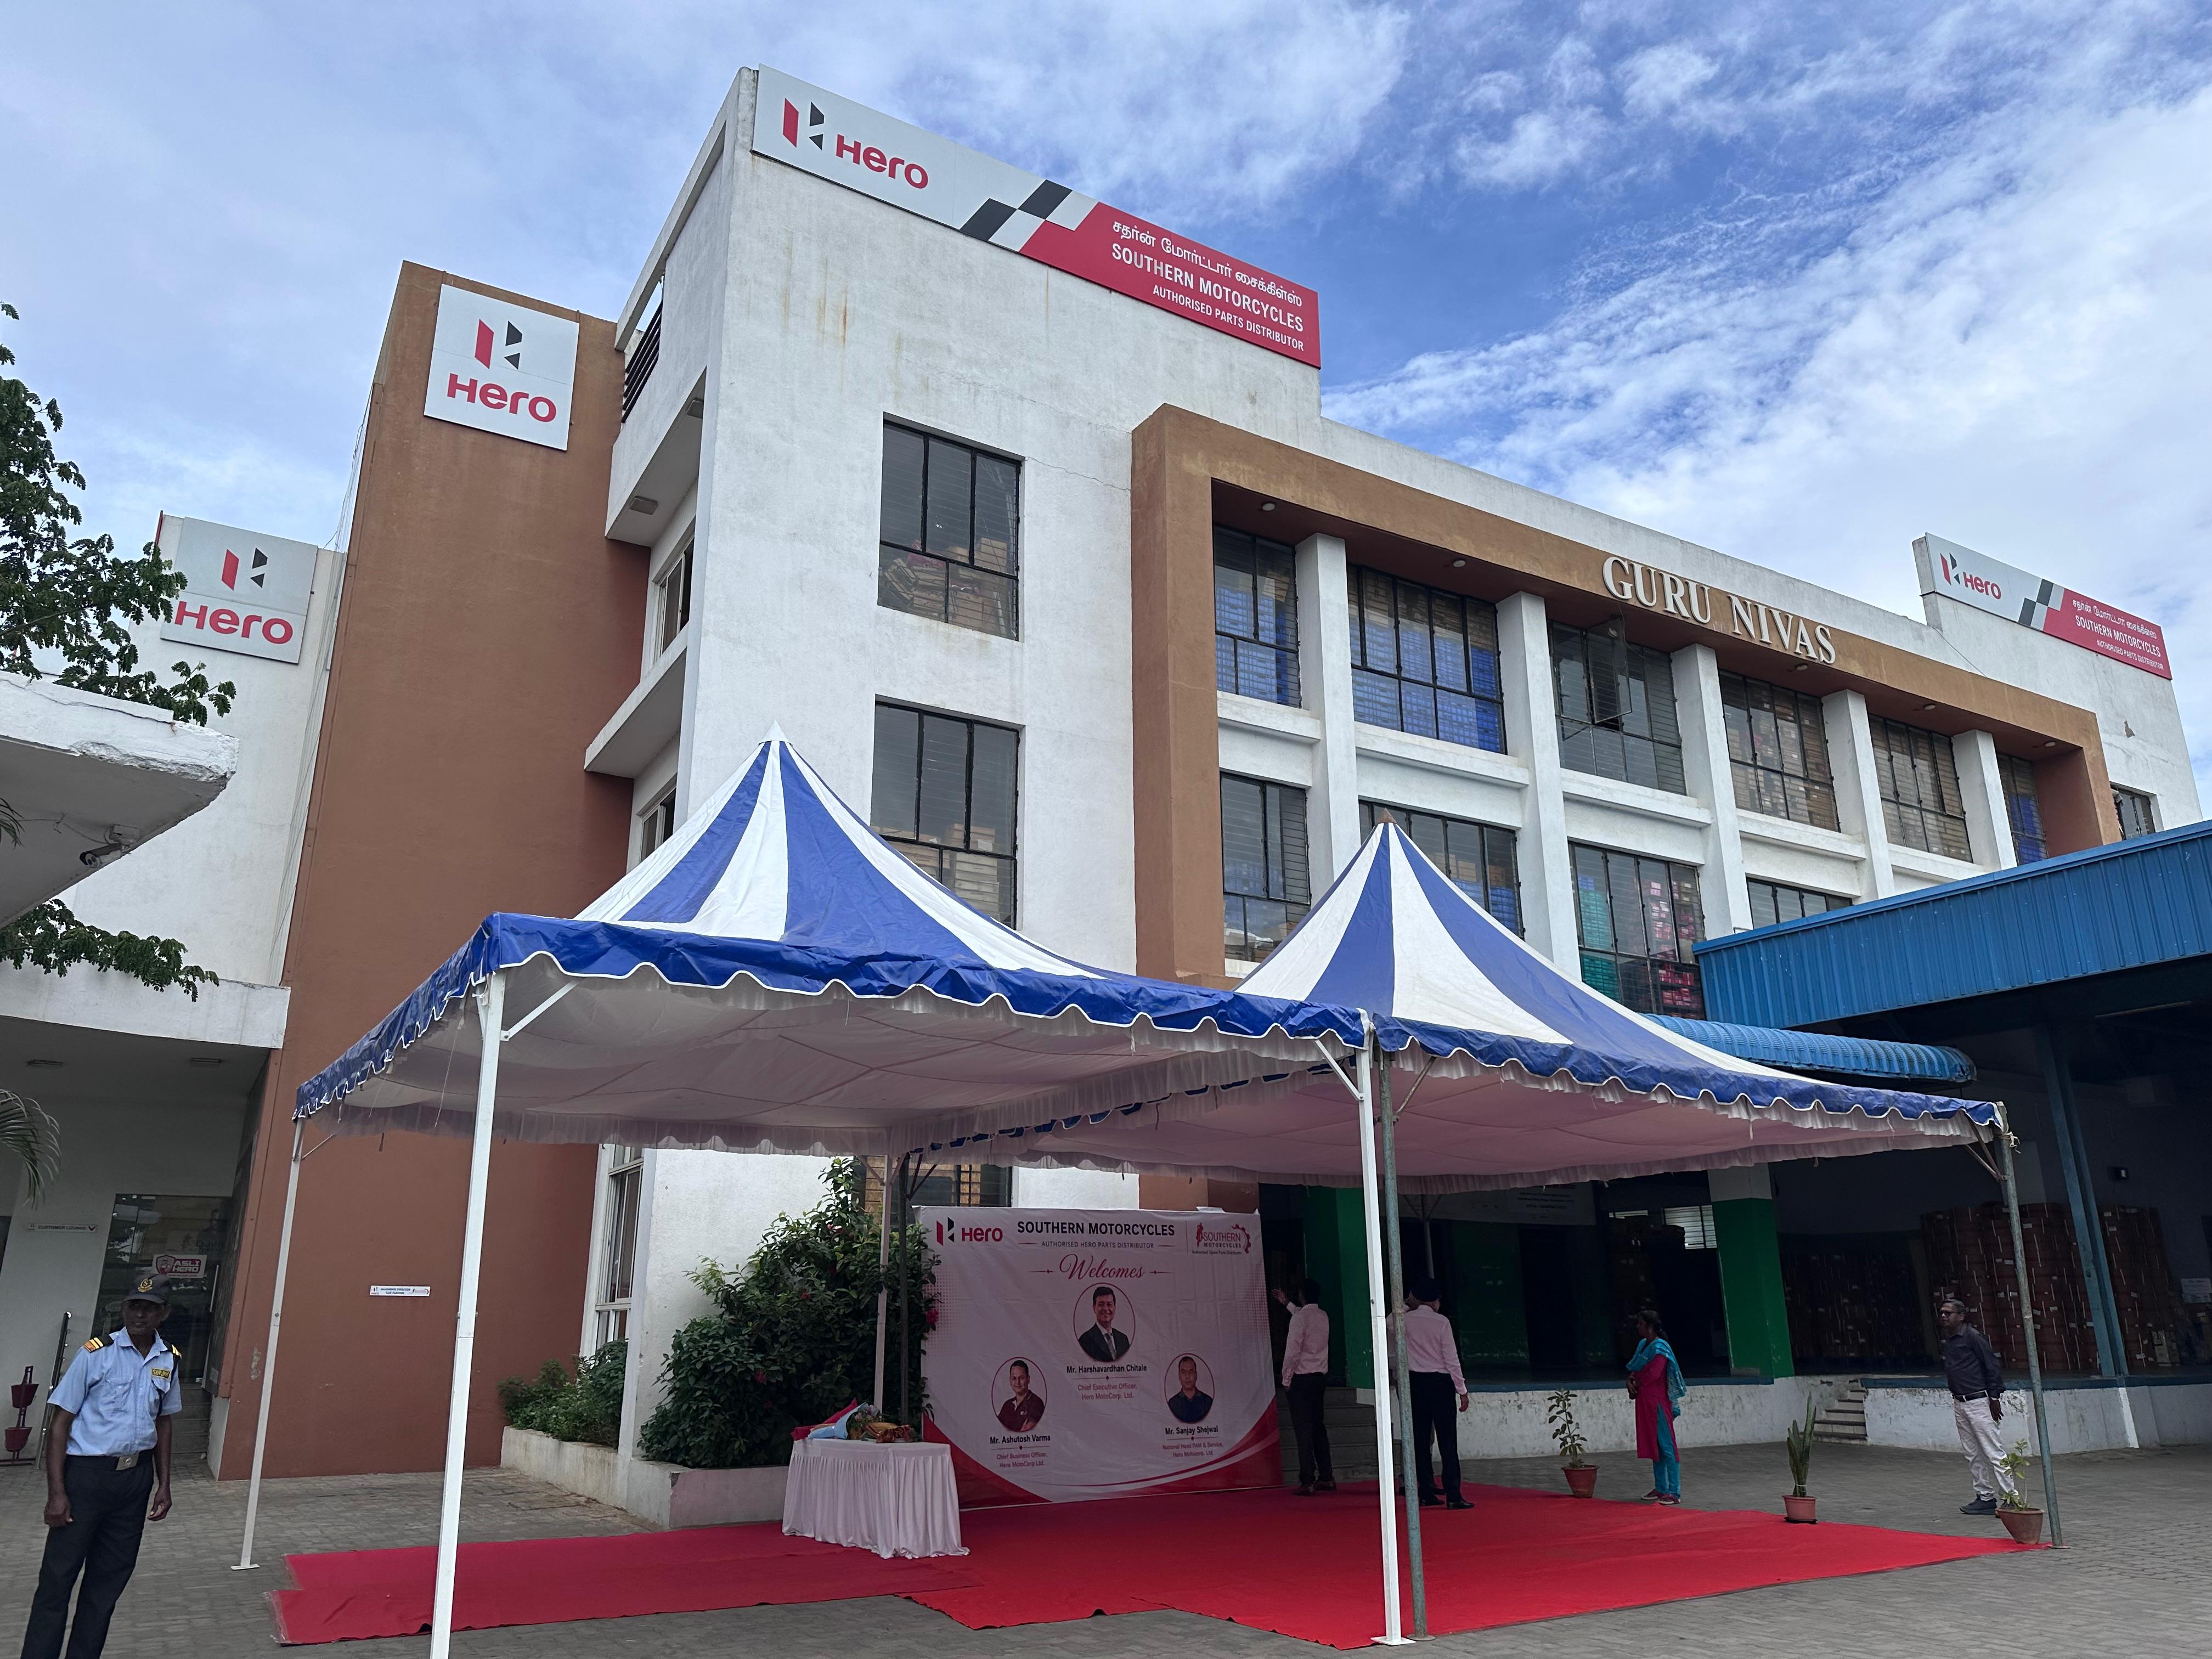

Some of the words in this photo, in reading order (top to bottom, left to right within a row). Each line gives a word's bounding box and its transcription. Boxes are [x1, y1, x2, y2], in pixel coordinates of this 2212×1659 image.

[836, 133, 929, 189] Hero
[1112, 243, 1194, 289] SOUTHERN
[1199, 277, 1304, 332] MOTORCYCLES
[1235, 271, 1302, 307] சைக்கிள்ஸ்
[1153, 285, 1212, 316] AUTHORISED
[1215, 308, 1243, 328] PARTS
[1246, 320, 1304, 351] DISTRIBUTOR
[447, 373, 556, 422] Hero
[1963, 572, 2001, 599] Hero
[174, 600, 293, 644] Hero
[1602, 556, 1711, 624] GURU
[1728, 594, 1836, 664] NIVAS
[2075, 615, 2113, 638] SOUTHERN
[2113, 629, 2161, 657] MOTORCYCLES
[2097, 640, 2124, 655] AUTHORISED
[2123, 649, 2137, 661] PARTS
[2137, 654, 2164, 670] DISTRIBUTOR
[962, 1227, 1003, 1242] Hero
[1017, 1221, 1085, 1234] SOUTHERN
[1088, 1223, 1175, 1236] MOTORCYCLES
[1203, 1232, 1241, 1242] SOUTHERN
[1059, 1254, 1145, 1280] Welcomes
[1079, 1365, 1125, 1373] Harshavardhan
[1002, 1435, 1030, 1443] Ashutosh
[1176, 1427, 1195, 1435] Sanjay
[1197, 1425, 1218, 1435] Shejwal
